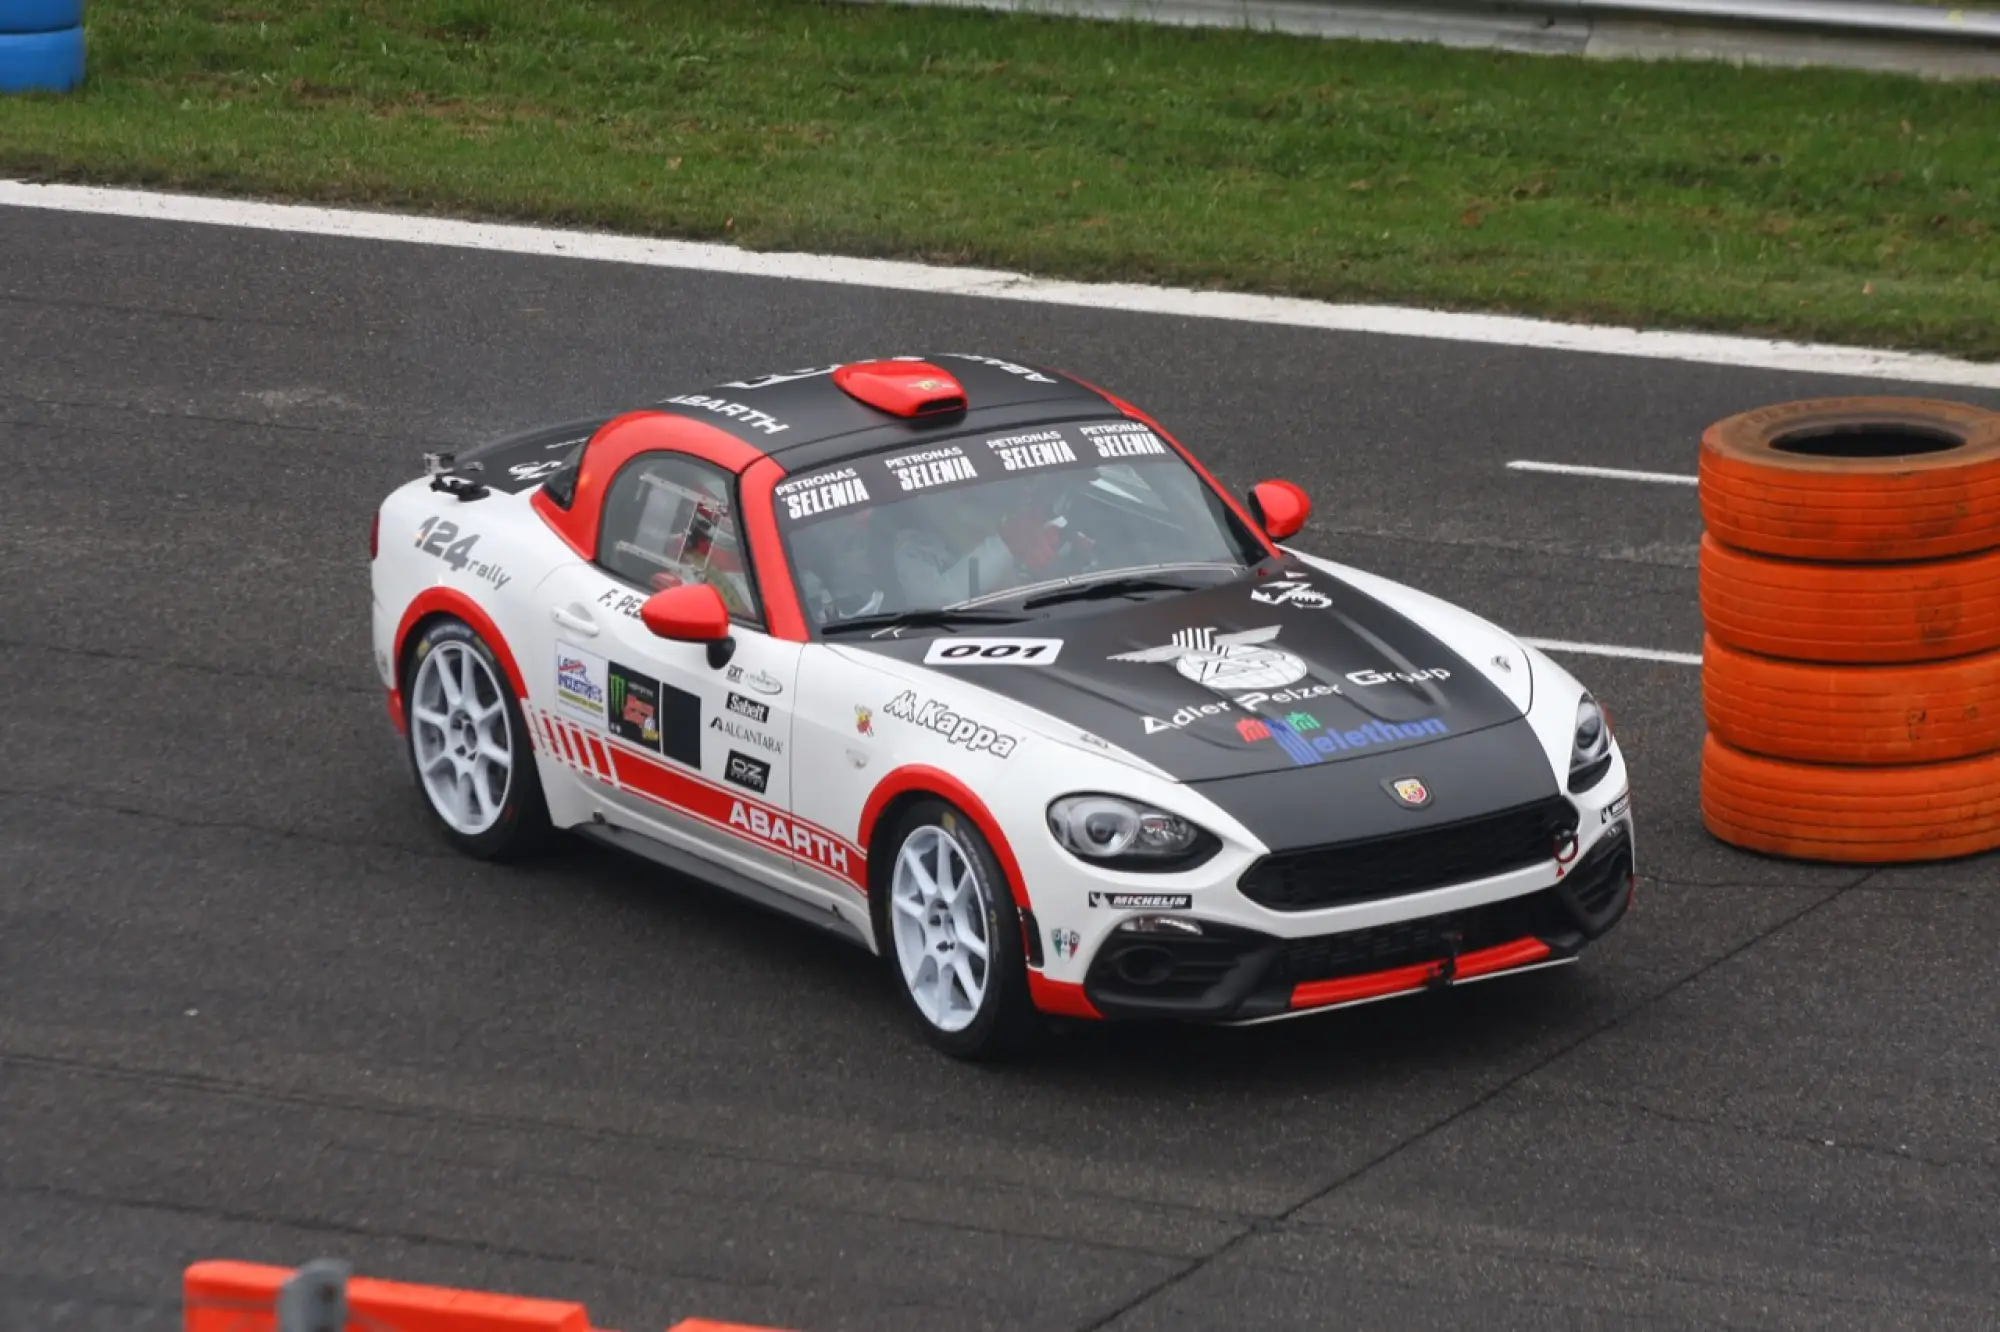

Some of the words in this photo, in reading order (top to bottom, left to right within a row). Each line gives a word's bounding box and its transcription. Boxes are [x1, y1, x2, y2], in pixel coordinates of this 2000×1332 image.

[986, 431, 1062, 449] PETRONAS
[1000, 439, 1078, 471] SELENIA
[1093, 432, 1166, 458] SELENIA
[884, 446, 964, 468] PETRONAS
[774, 467, 857, 496] PETRONAS
[898, 456, 978, 491] SELENIA
[787, 477, 870, 519] SELENIA
[414, 516, 481, 572] 124
[467, 559, 512, 591] rally
[940, 645, 1048, 658] 001
[1140, 698, 1232, 735] Adler
[1233, 681, 1343, 712] Pelzer
[1345, 667, 1452, 686] Group
[724, 721, 783, 754] ALCANTARA
[916, 699, 1018, 759] Kappa
[1266, 715, 1448, 766] Telethon
[732, 758, 763, 778] OZ
[728, 800, 850, 874] ABARTH
[1113, 894, 1187, 906] MICHELIN
